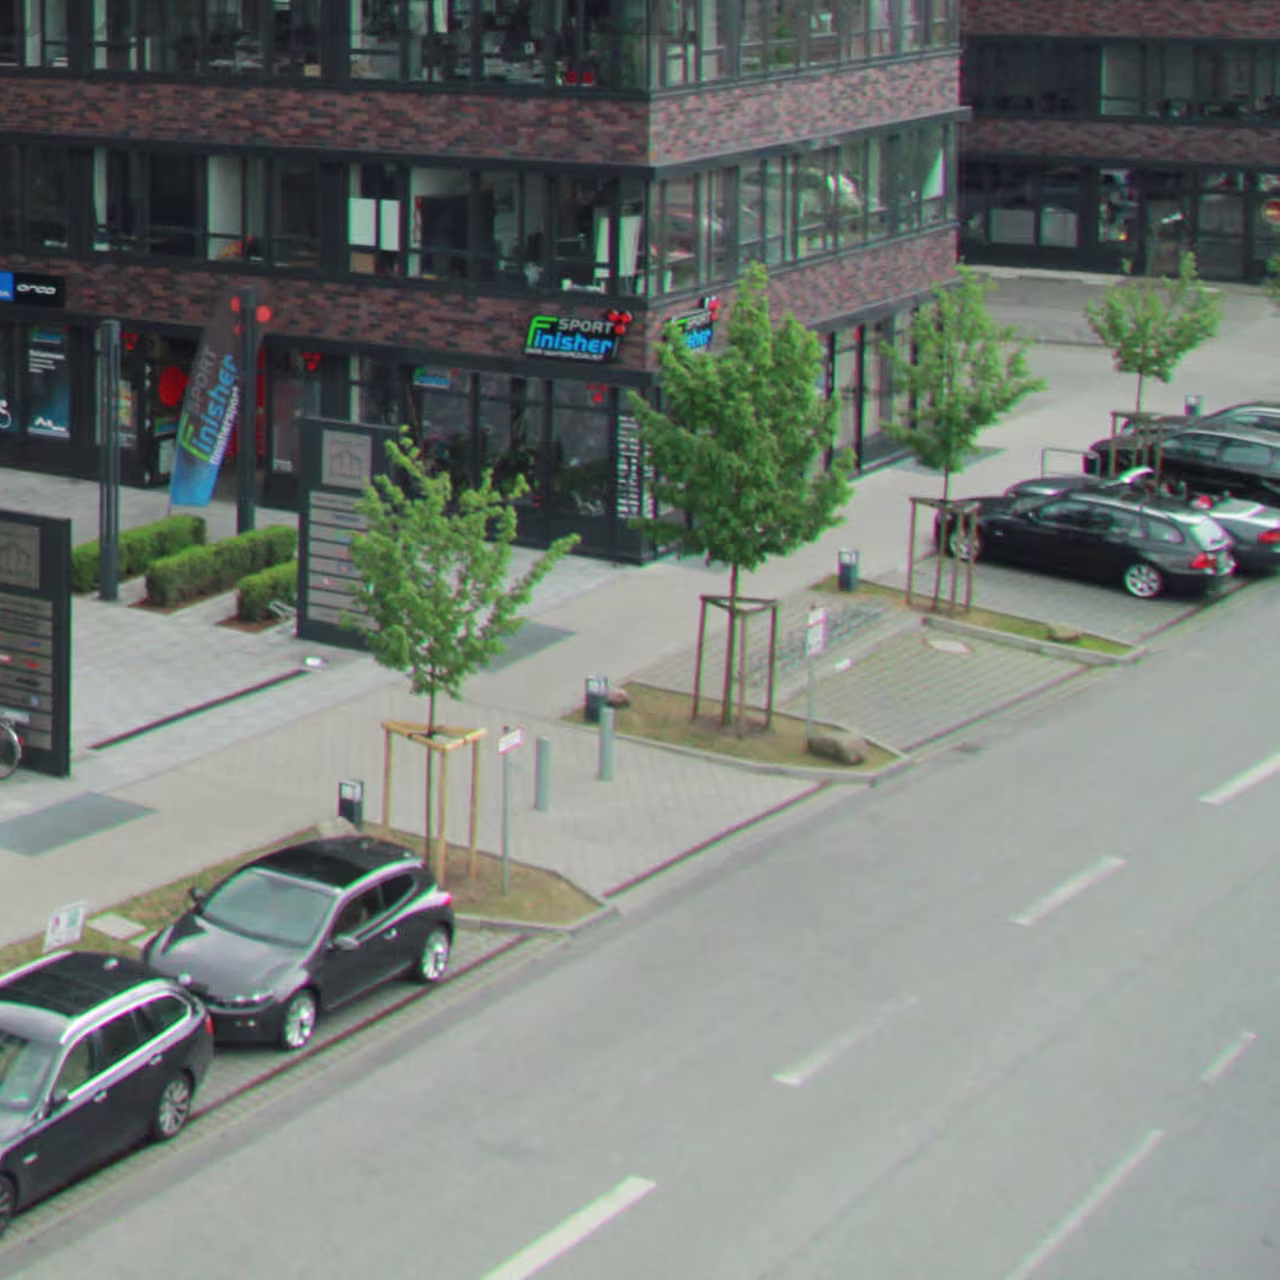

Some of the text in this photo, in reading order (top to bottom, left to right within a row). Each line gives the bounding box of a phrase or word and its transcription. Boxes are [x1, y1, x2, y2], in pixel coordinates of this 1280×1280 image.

[527, 315, 614, 354] Finisher
[558, 318, 614, 334] SPORT
[180, 354, 238, 462] Finisher
